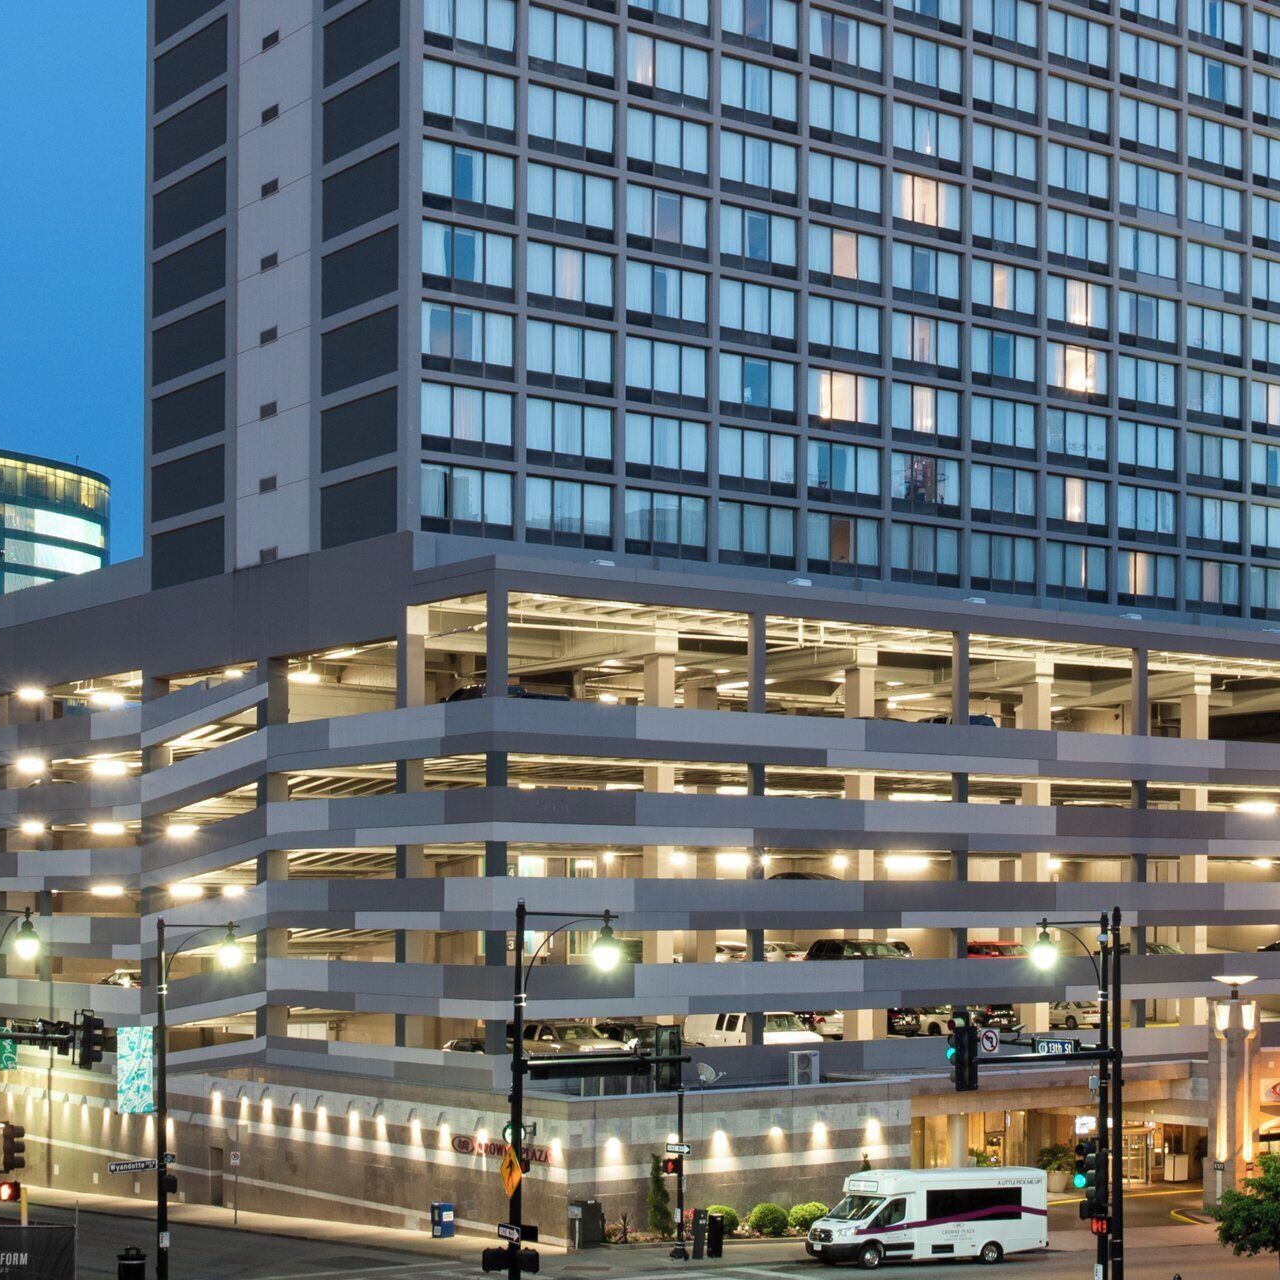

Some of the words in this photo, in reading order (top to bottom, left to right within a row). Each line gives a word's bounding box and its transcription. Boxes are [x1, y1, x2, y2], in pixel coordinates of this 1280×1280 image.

[508, 868, 515, 877] 4
[508, 940, 515, 950] 3
[1049, 1042, 1062, 1054] 13th
[1065, 1043, 1072, 1054] St
[110, 1161, 145, 1173] Wyandotte
